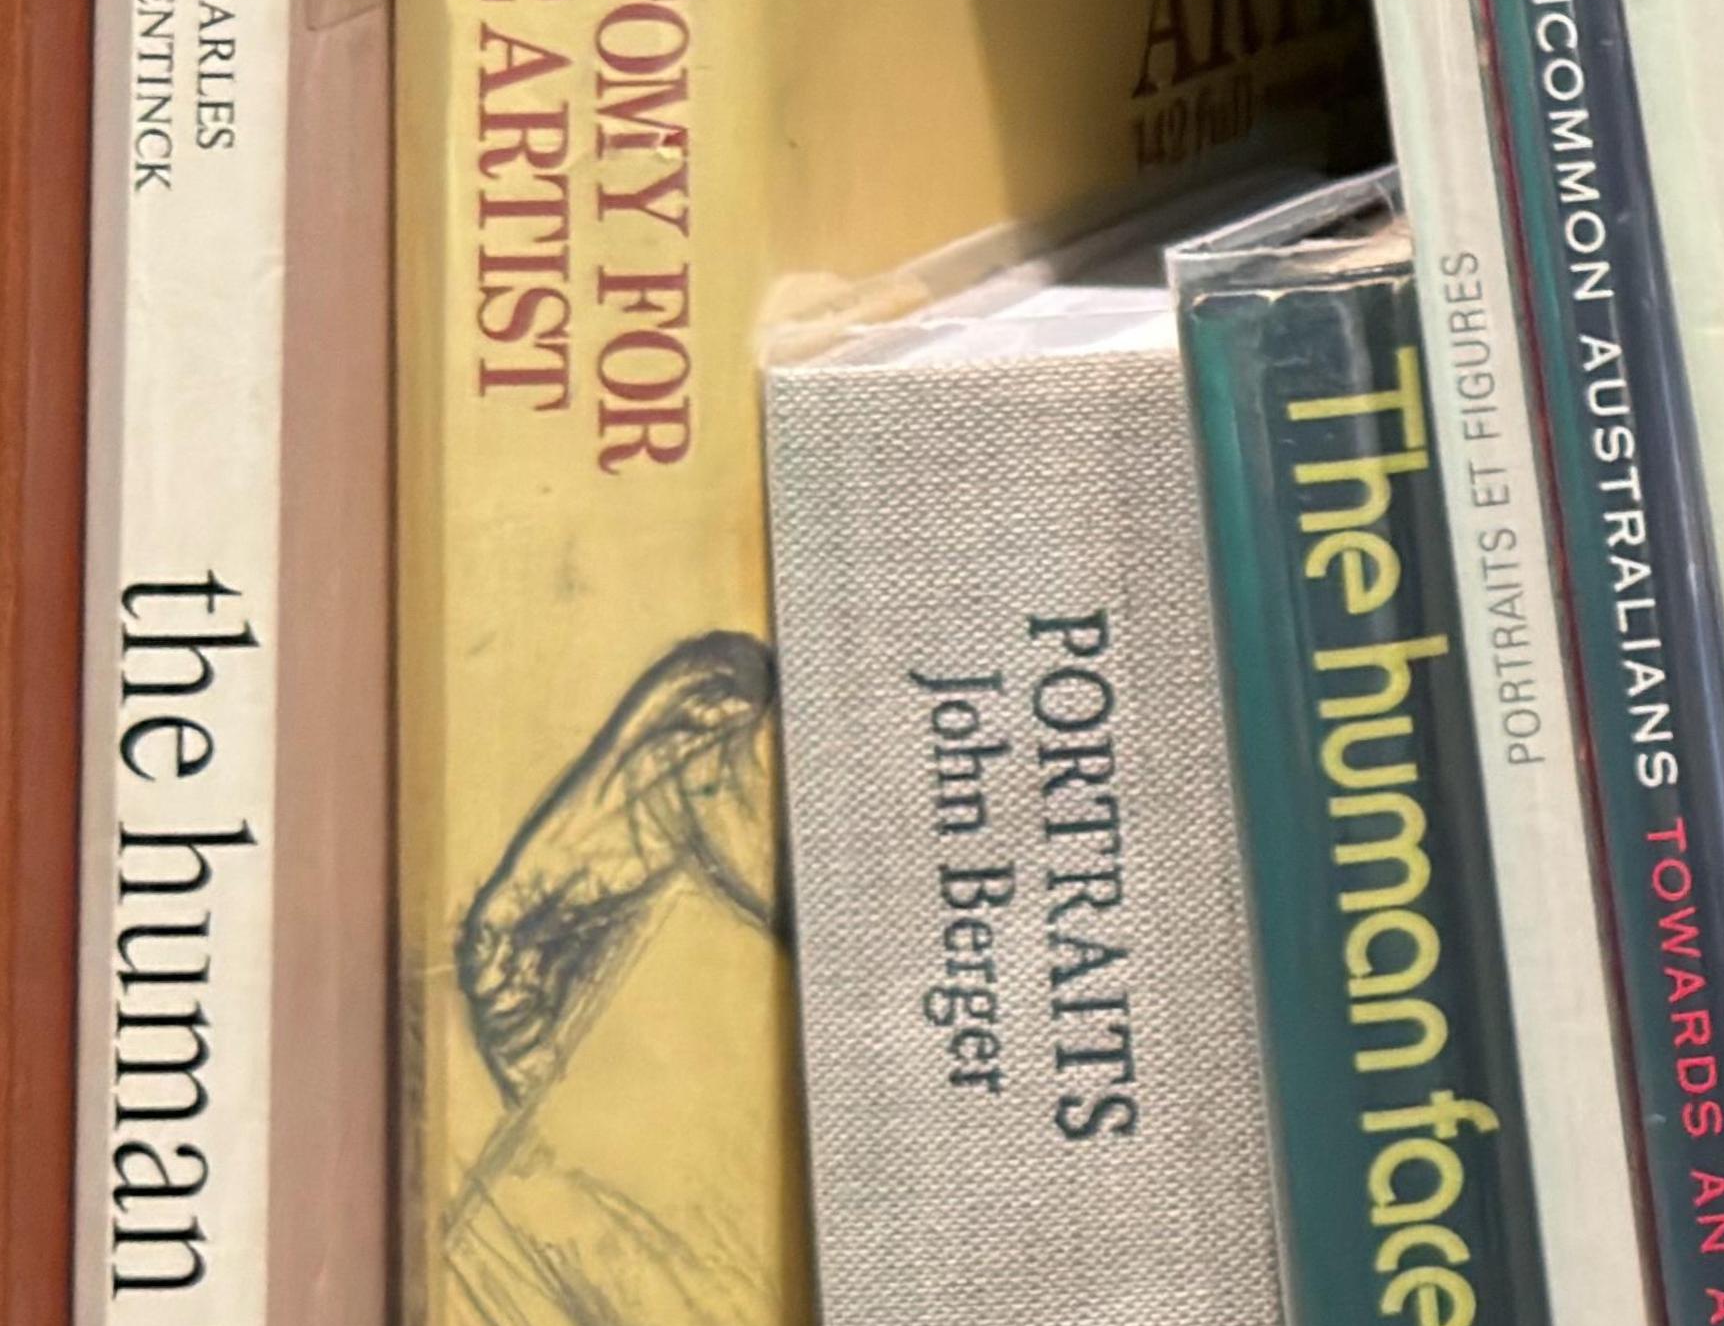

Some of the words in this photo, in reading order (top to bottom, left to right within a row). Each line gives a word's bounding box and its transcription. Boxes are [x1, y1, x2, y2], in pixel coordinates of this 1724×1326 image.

[477, 21, 573, 411] ARTIST
[595, 263, 694, 475] FOR
[1440, 250, 1498, 445] FIGURES
[1284, 346, 1426, 616] The
[1471, 461, 1511, 510] ET
[118, 568, 261, 782] the
[908, 667, 1013, 837] John
[1480, 526, 1545, 767] PORTRAITS
[1578, 332, 1681, 792] AUSTRALIANS
[1645, 815, 1724, 1140] TOWARDS
[1026, 607, 1140, 1142] PORTRAITS
[1313, 630, 1449, 1073] human
[111, 819, 258, 1299] human
[922, 862, 1015, 1095] Berger
